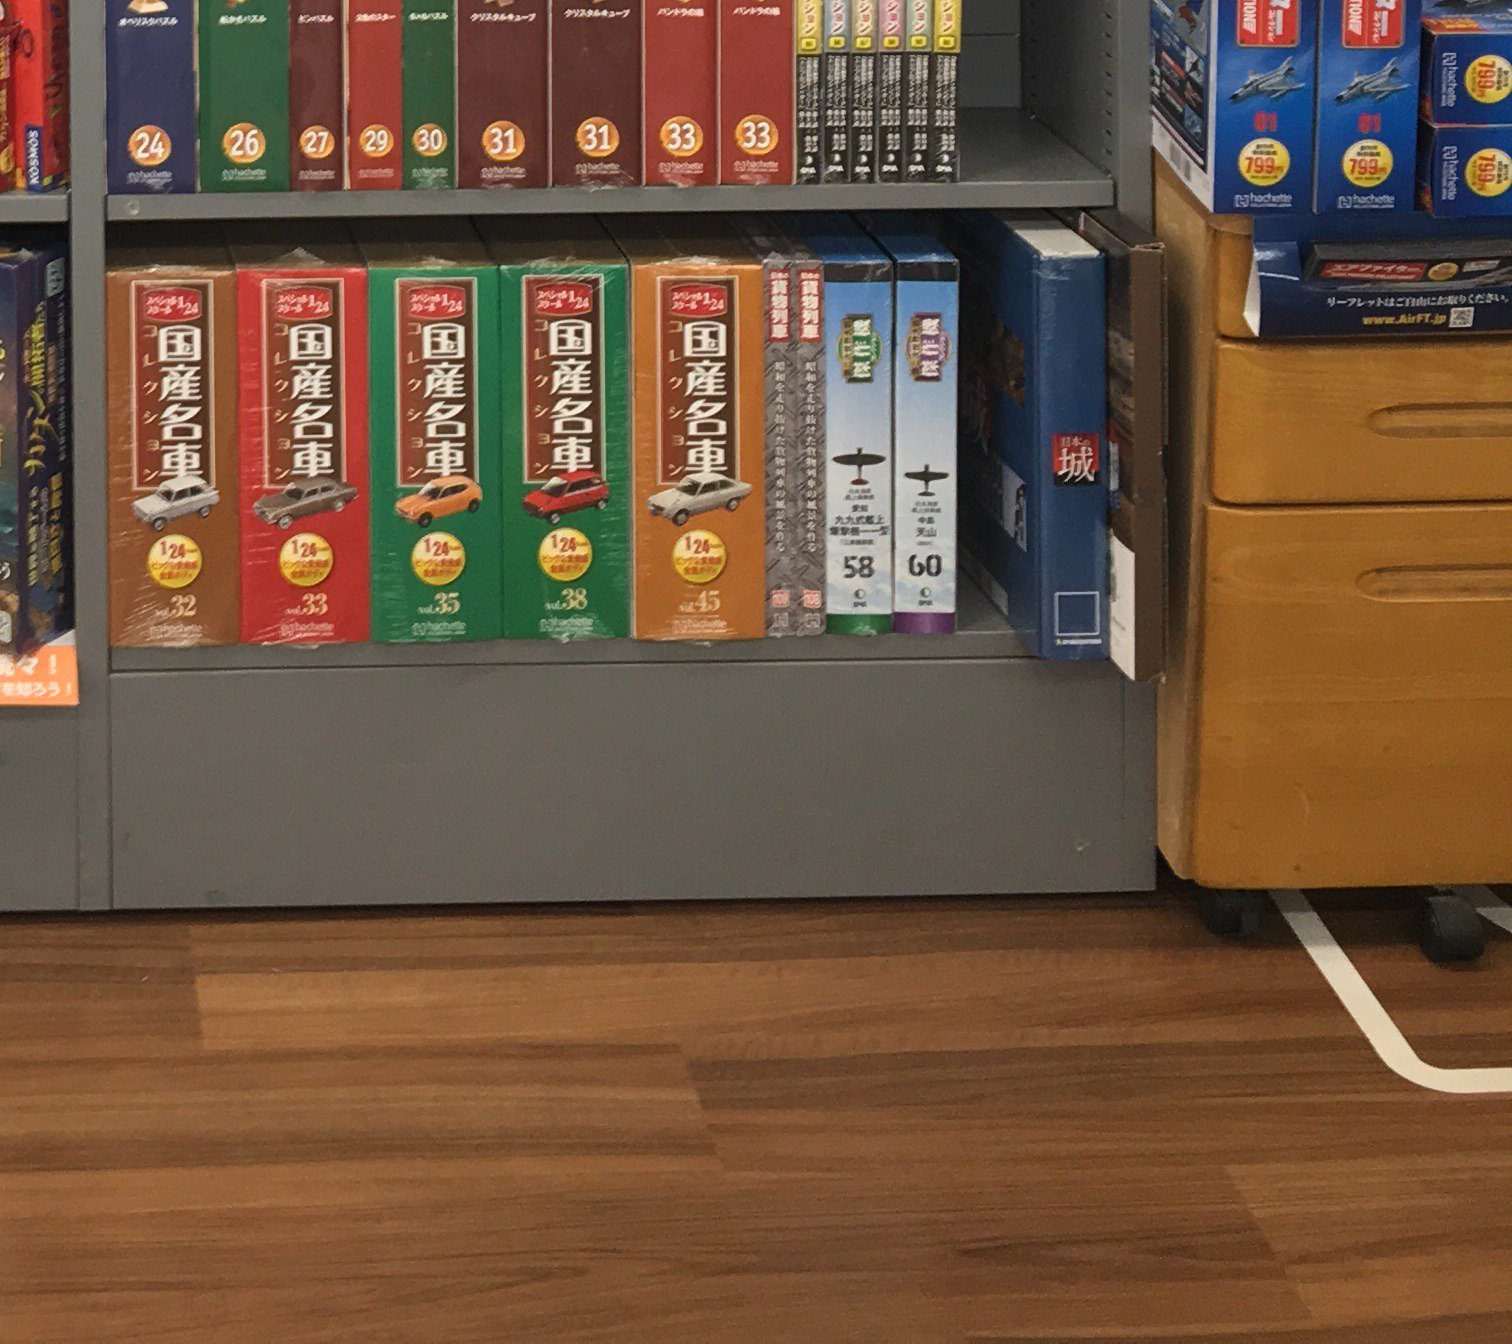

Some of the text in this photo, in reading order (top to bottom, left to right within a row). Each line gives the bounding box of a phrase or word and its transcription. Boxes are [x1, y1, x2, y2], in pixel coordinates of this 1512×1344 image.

[135, 132, 166, 159] 24
[230, 131, 259, 157] 26
[304, 131, 330, 154] 27
[364, 129, 389, 152] 29
[418, 128, 443, 152] 30
[488, 129, 518, 154] 31
[584, 124, 611, 149] 31
[667, 122, 696, 149] 33
[742, 121, 772, 147] 33
[28, 128, 39, 186] KOSMOS
[157, 322, 204, 478] 国産名車
[288, 322, 335, 478] 国産名車
[421, 321, 467, 477] 国産名車
[548, 318, 592, 473] 国産名車
[682, 320, 727, 475] 国産名車
[1057, 448, 1096, 482] 城
[843, 555, 875, 579] 58
[907, 553, 943, 578] 60
